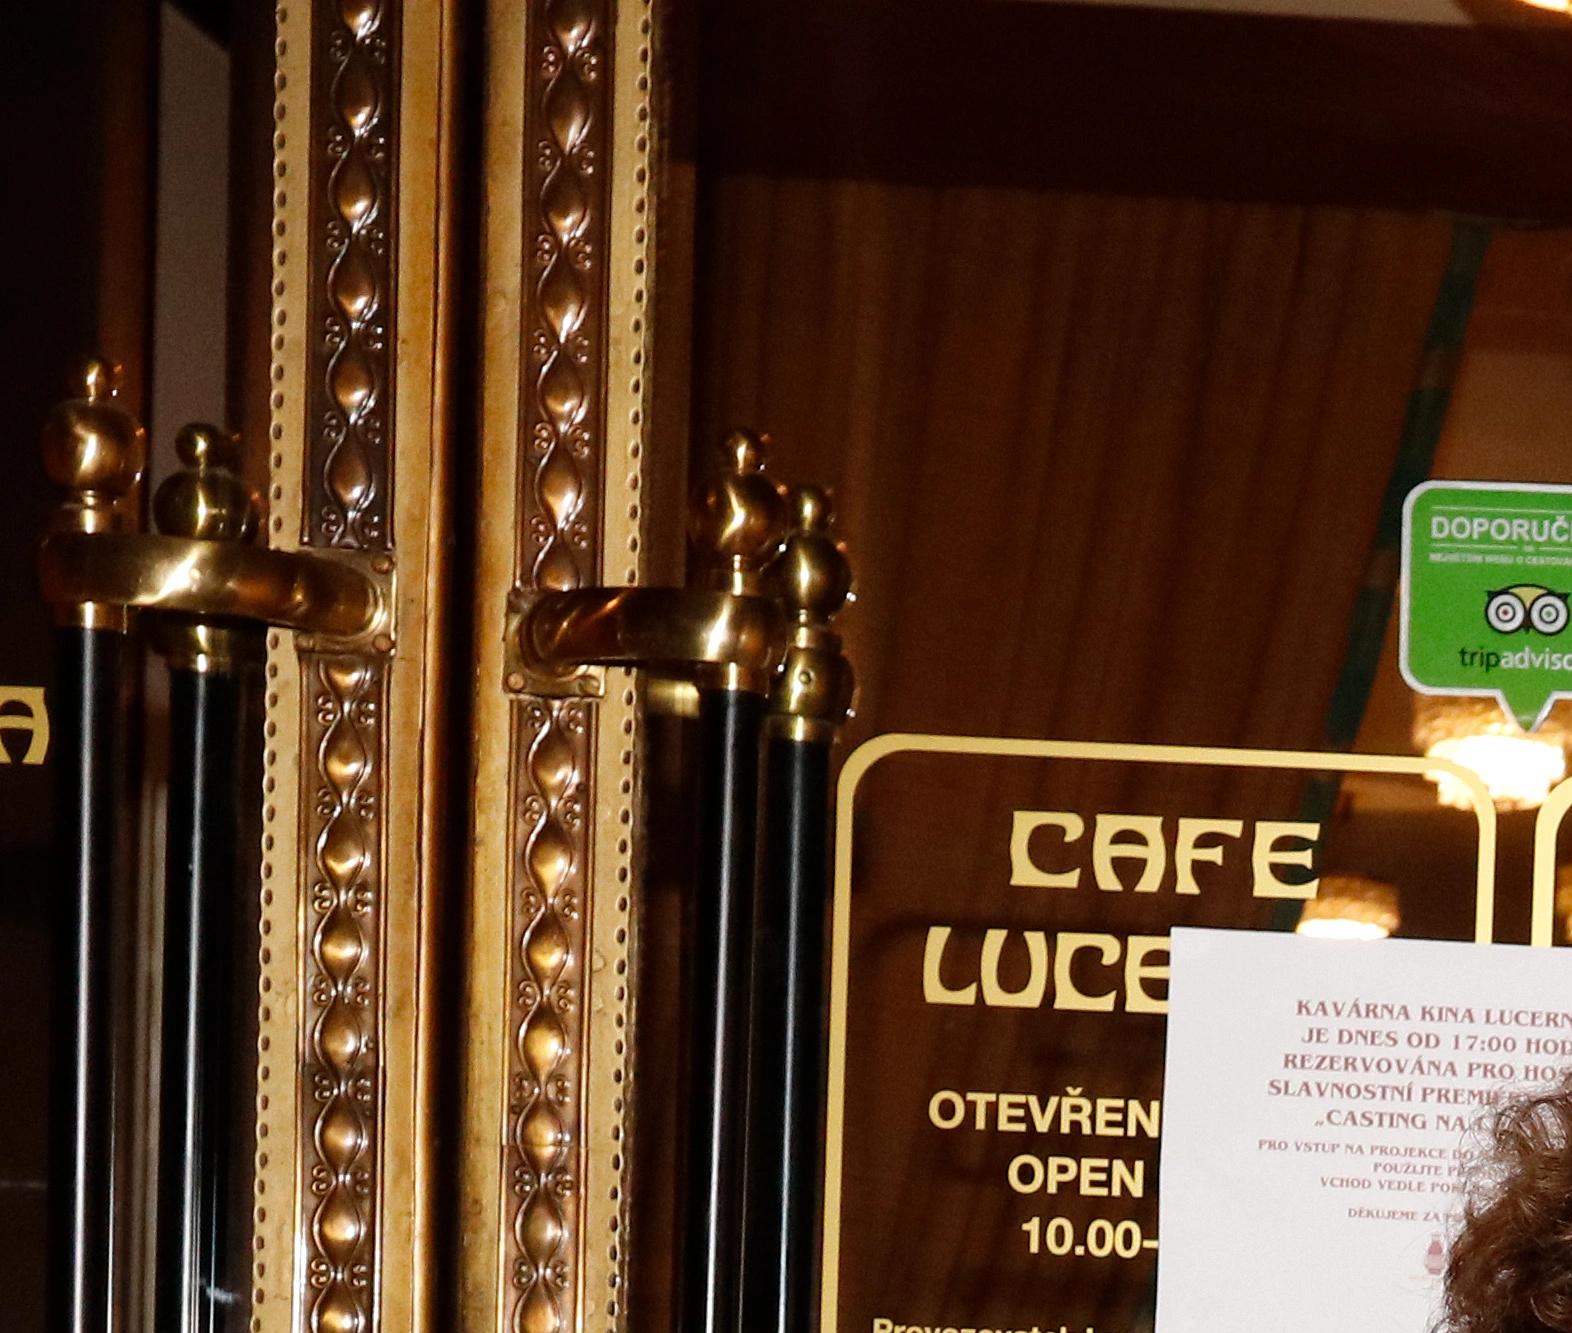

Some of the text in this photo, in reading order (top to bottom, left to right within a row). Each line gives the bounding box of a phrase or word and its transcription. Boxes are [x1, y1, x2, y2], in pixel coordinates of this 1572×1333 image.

[1010, 810, 1320, 900] CAFE
[923, 926, 1169, 1014] LUCE
[1296, 998, 1411, 1022] KAVÁRNA
[1420, 1005, 1475, 1024] KINA
[1301, 1027, 1329, 1044] JE
[1338, 1028, 1398, 1047] DNES
[1407, 1032, 1440, 1049] OD
[1452, 1034, 1517, 1052] 17:00
[1283, 1053, 1458, 1077] REZERVOVÁNA
[1467, 1062, 1515, 1081] PRO
[1268, 1079, 1413, 1103] SLAVNOSTNÍ
[928, 1086, 1161, 1138] OTEVŘEN
[1436, 1114, 1466, 1132] NA
[1258, 1139, 1289, 1151] PRO
[1295, 1141, 1340, 1154] VSTUP
[1345, 1143, 1365, 1155] NA
[1370, 1145, 1447, 1159] PROJEKCE
[1007, 1154, 1145, 1198] OPEN
[1320, 1177, 1371, 1190] VCHOD
[1378, 1180, 1425, 1192] VEDLE
[1021, 1216, 1159, 1259] 10.00-
